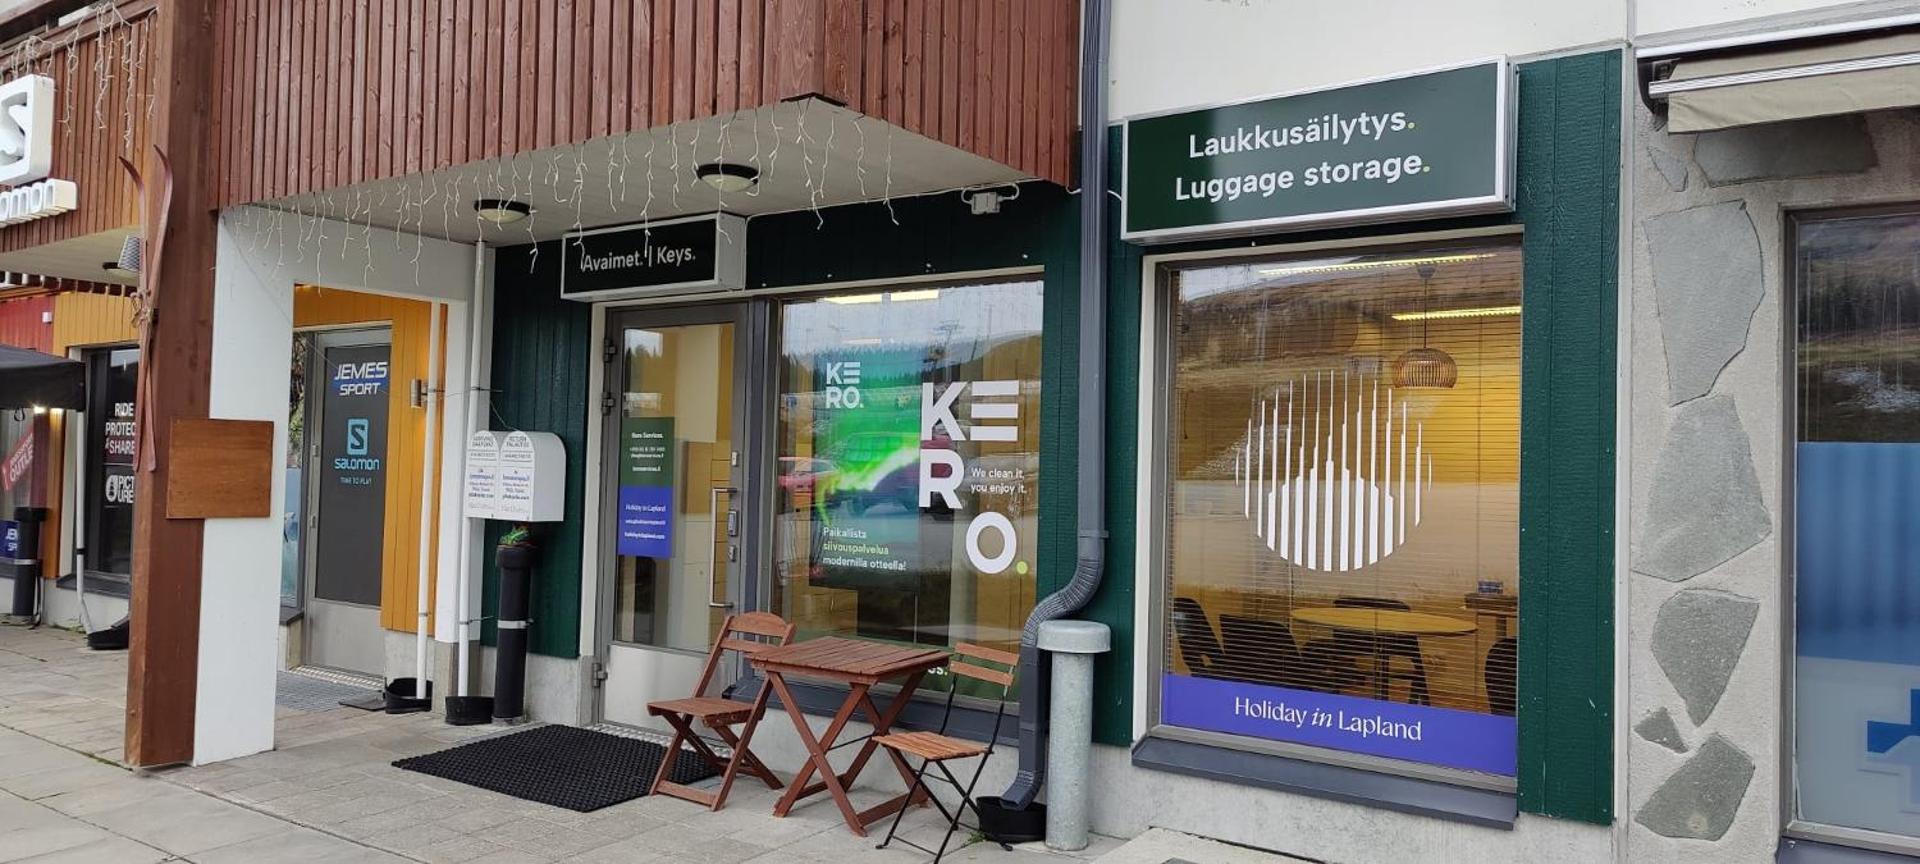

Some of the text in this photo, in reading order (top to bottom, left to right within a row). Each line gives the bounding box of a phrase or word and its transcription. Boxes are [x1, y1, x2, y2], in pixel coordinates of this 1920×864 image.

[1189, 111, 1415, 158] Laukkusäilytys.
[1175, 154, 1430, 203] Luggage storage.
[657, 245, 696, 267] Keys.
[334, 361, 388, 380] JEMES
[339, 382, 381, 396] SPORT
[115, 403, 134, 417] RIDE
[105, 422, 136, 436] PROTEC
[334, 458, 380, 470] salomon
[971, 467, 986, 477] We
[989, 467, 1013, 478] clean
[971, 484, 987, 495] you
[989, 483, 1015, 495] enjoy
[823, 526, 867, 539] Paikallista
[823, 541, 889, 556] siivouspalvelua
[822, 556, 868, 568] modernilla
[1234, 696, 1422, 741] Holiday in Lapland
